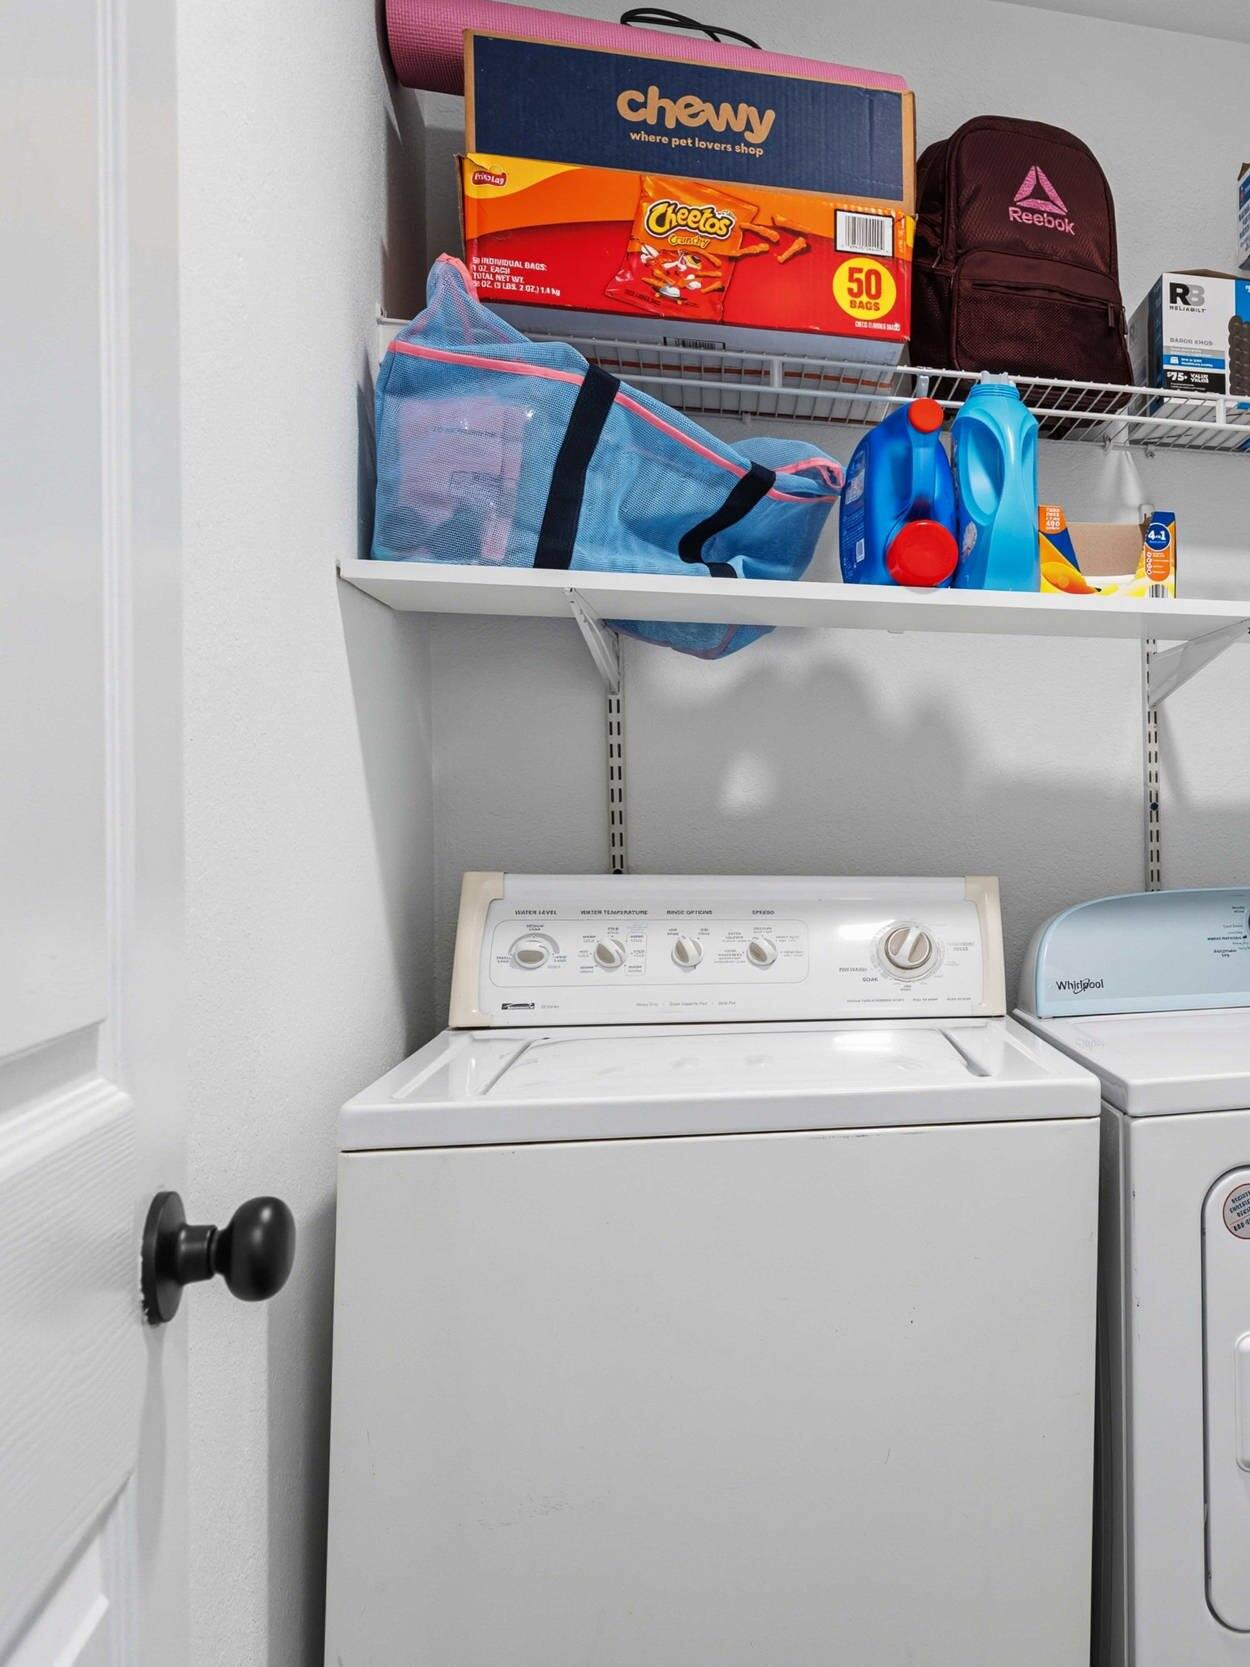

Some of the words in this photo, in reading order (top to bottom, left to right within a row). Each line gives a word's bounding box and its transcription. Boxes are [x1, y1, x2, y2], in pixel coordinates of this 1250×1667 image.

[616, 85, 776, 144] chewy
[630, 131, 669, 144] where
[671, 137, 693, 148] pet
[695, 137, 732, 152] lovers
[735, 143, 764, 157] shop
[646, 201, 734, 238] Cheetos
[1008, 206, 1076, 236] Reebok
[668, 234, 711, 249] Crunchy
[481, 257, 523, 269] INDIVIDUAL
[490, 266, 511, 275] EACH
[473, 272, 494, 280] TOTAL
[495, 274, 510, 282] NET
[847, 267, 883, 300] 50
[849, 300, 881, 312] BAGS
[1055, 978, 1105, 995] Whirlpool
